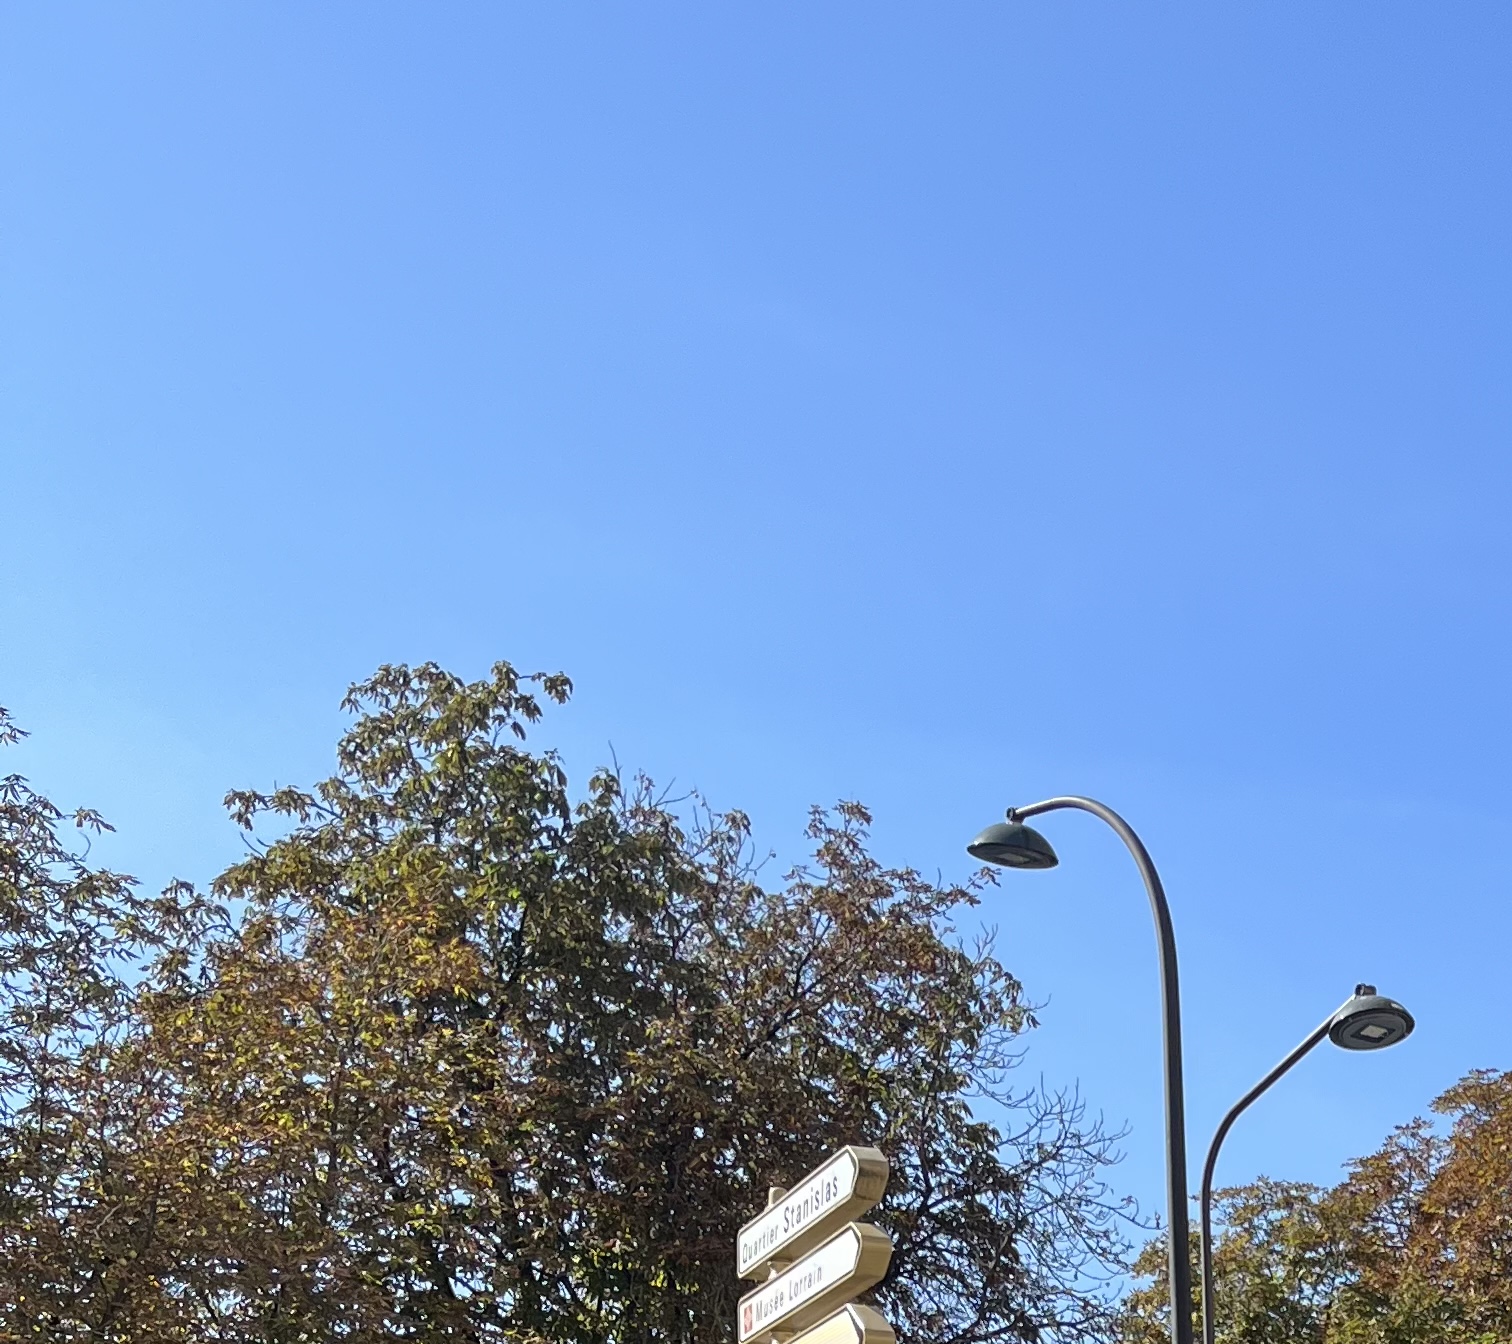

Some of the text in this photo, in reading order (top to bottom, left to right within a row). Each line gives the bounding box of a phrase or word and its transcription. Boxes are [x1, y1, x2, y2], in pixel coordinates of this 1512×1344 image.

[742, 1175, 838, 1264] Quartier Stanislas
[755, 1265, 822, 1322] Musée Lorrain
